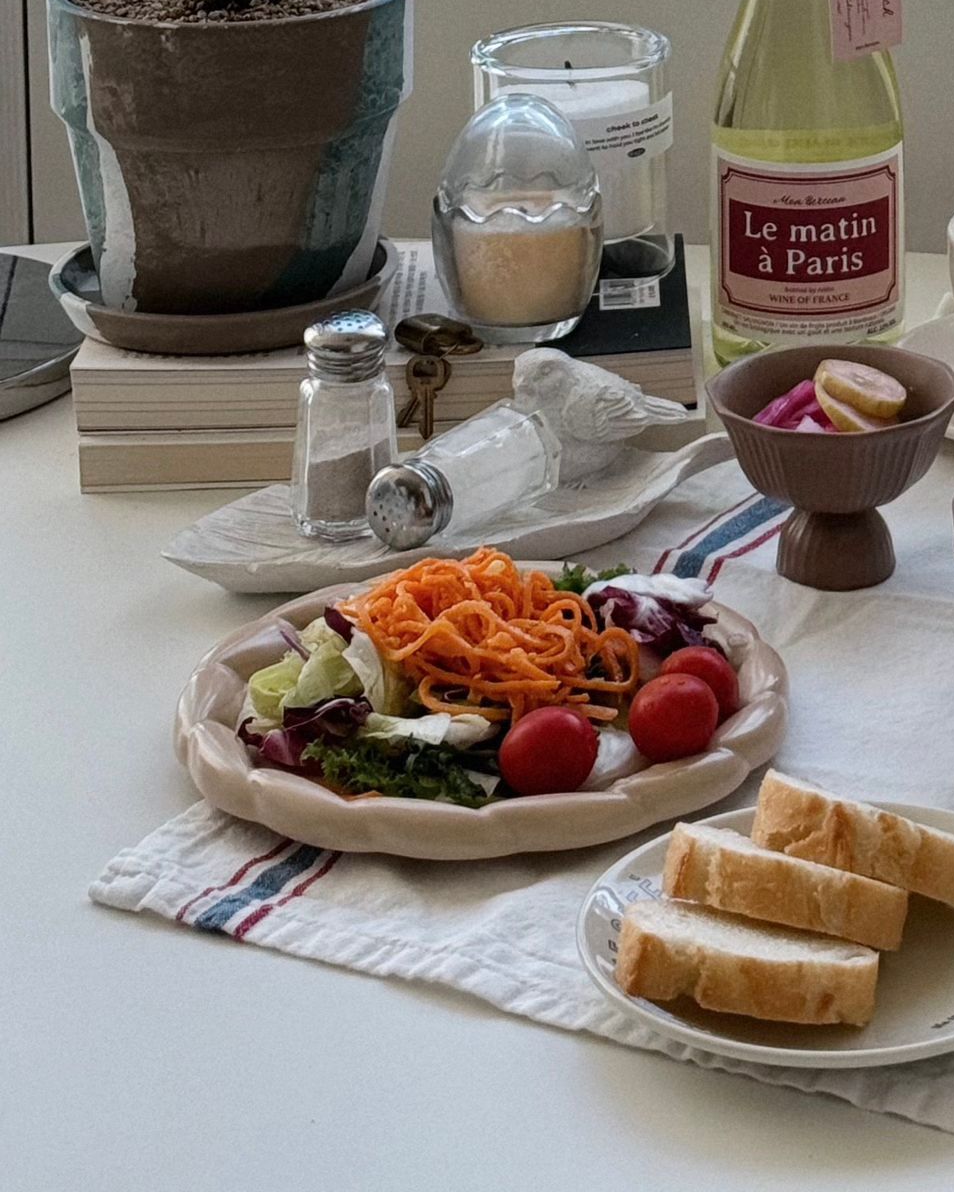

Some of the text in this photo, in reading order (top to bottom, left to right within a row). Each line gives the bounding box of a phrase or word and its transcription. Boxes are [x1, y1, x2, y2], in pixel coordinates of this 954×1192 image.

[743, 210, 877, 242] Le matin
[758, 246, 864, 275] à Paris
[769, 292, 850, 304] WINE OF FRANCE
